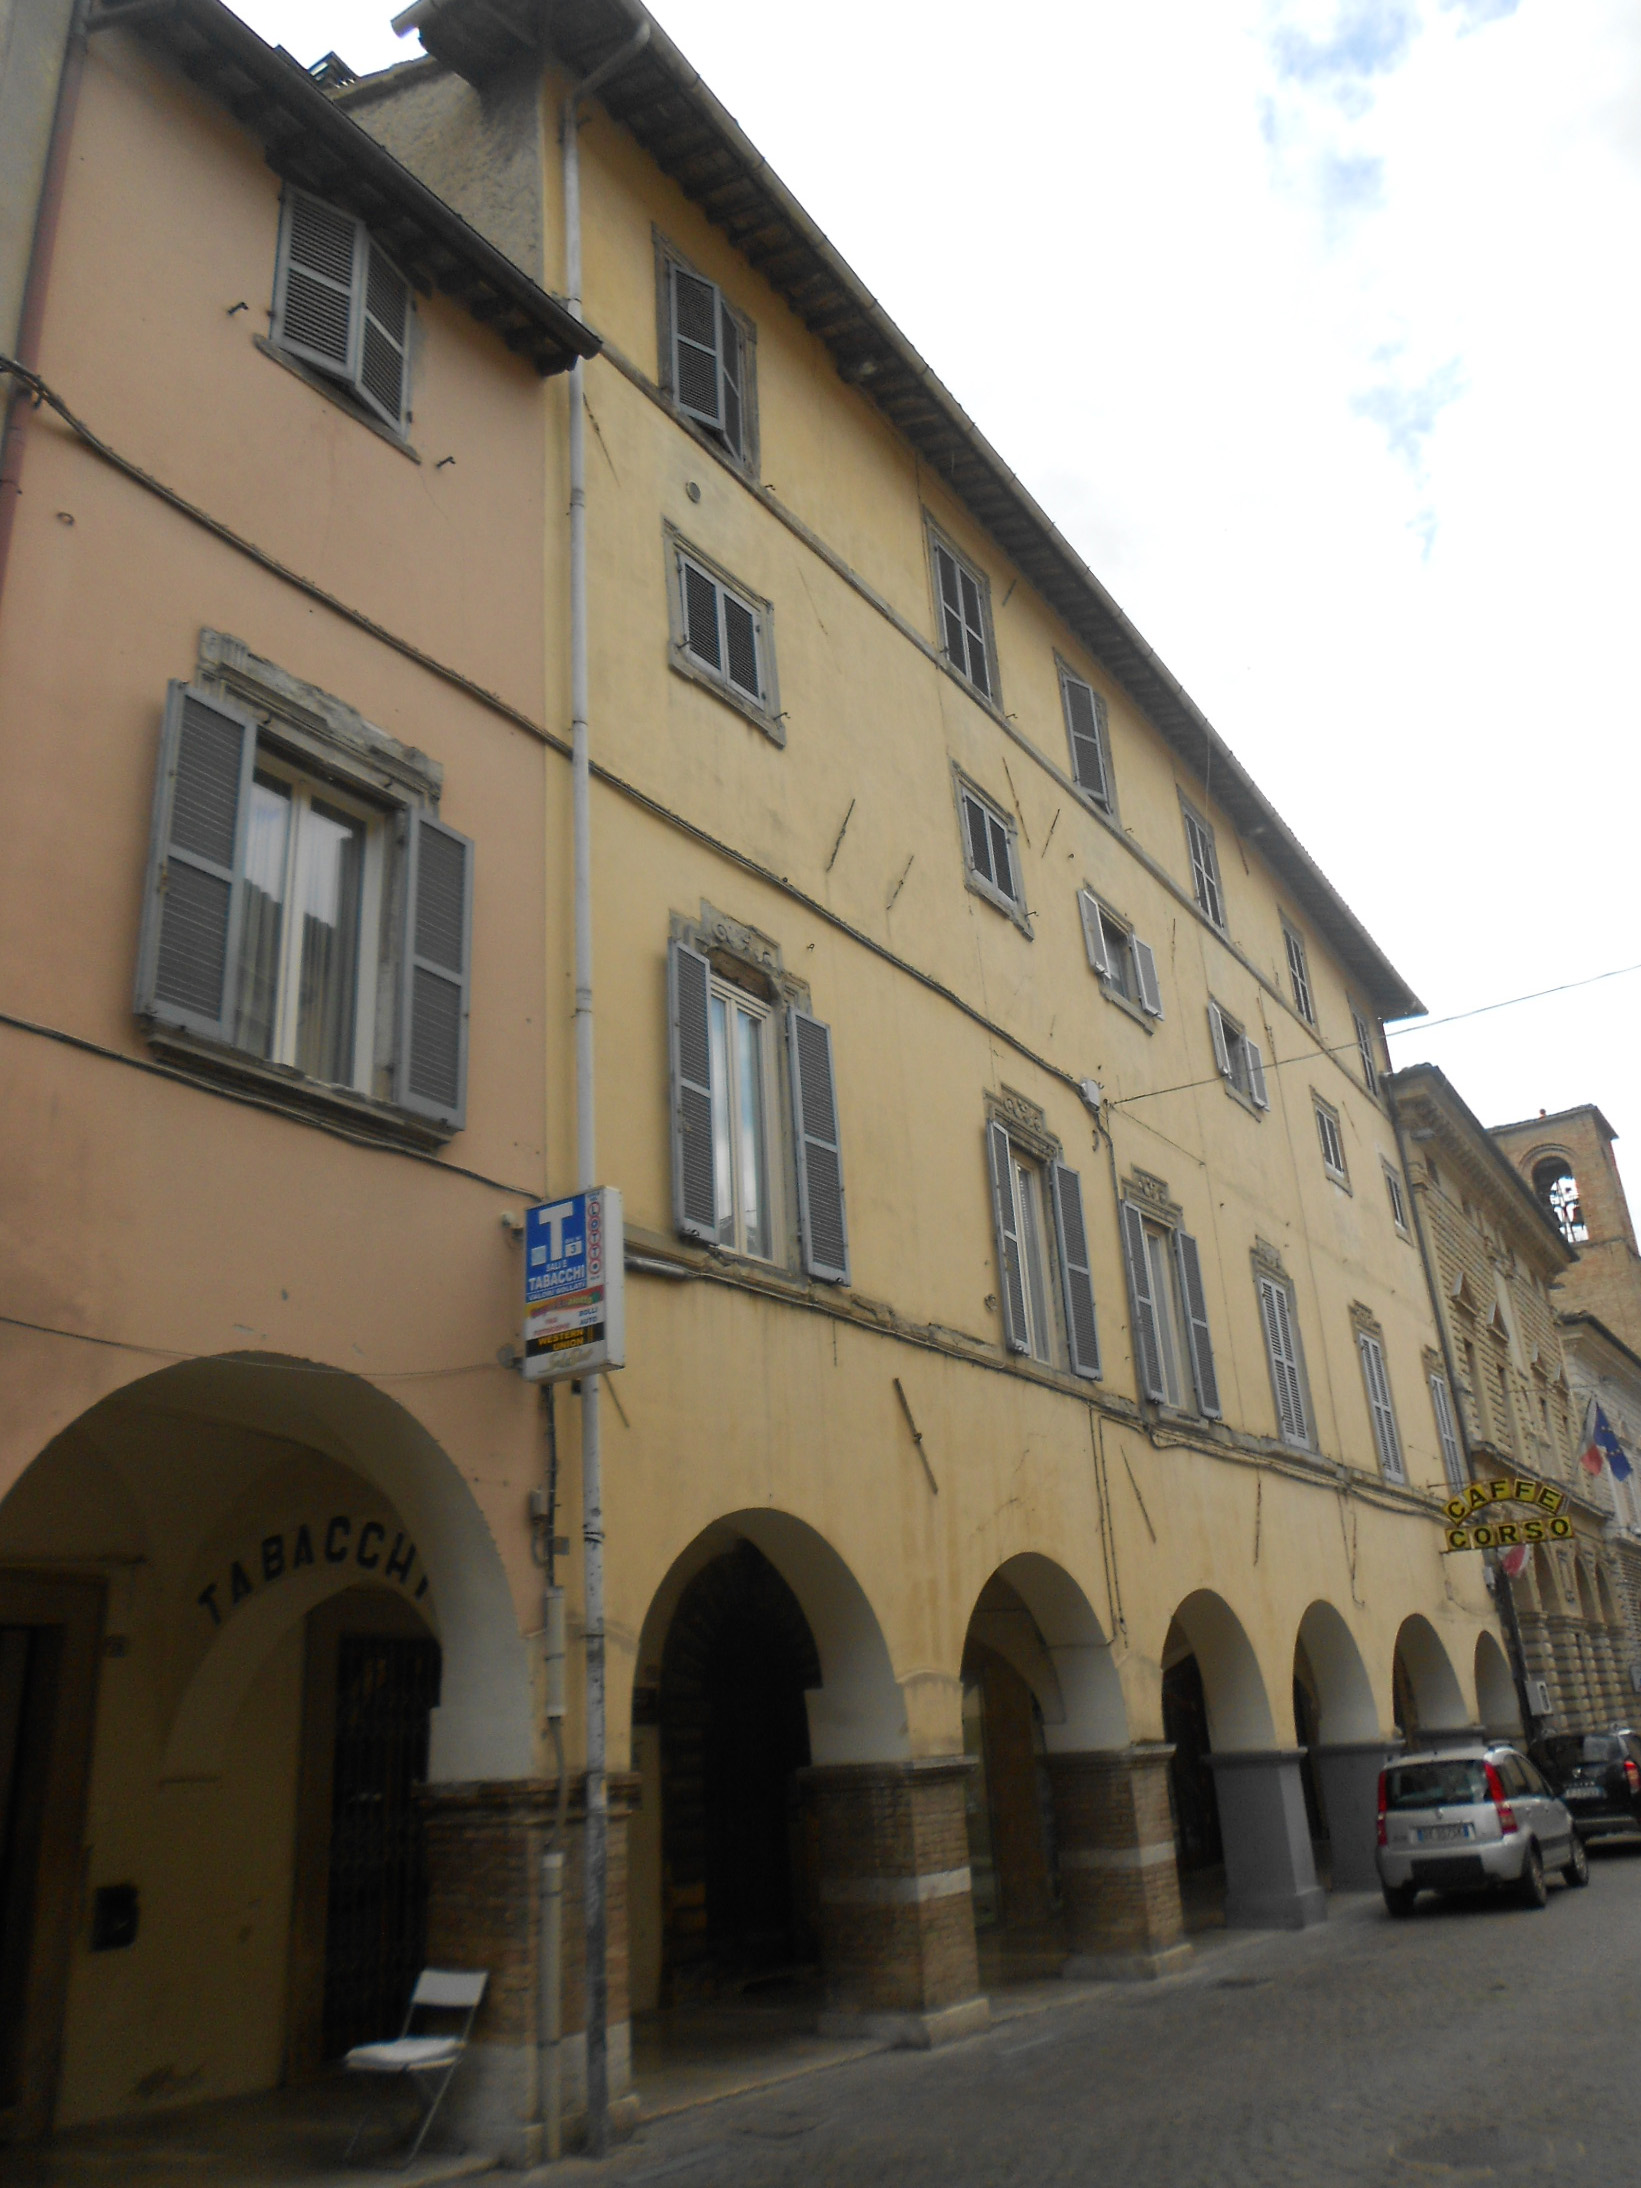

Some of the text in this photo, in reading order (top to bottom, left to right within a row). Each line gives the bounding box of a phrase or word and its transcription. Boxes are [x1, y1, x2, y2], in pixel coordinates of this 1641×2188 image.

[538, 1201, 575, 1261] T
[588, 1202, 601, 1274] LOTTO
[528, 1264, 585, 1291] TABACCHI
[546, 1262, 561, 1272] SALI
[579, 1307, 598, 1317] BOLLI
[580, 1316, 598, 1325] AUTO
[537, 1329, 585, 1345] WESTERN
[552, 1338, 584, 1351] UNION
[1447, 1480, 1561, 1519] CAFFE
[1449, 1518, 1570, 1549] CORSO
[197, 1515, 430, 1626] TABACCHI
